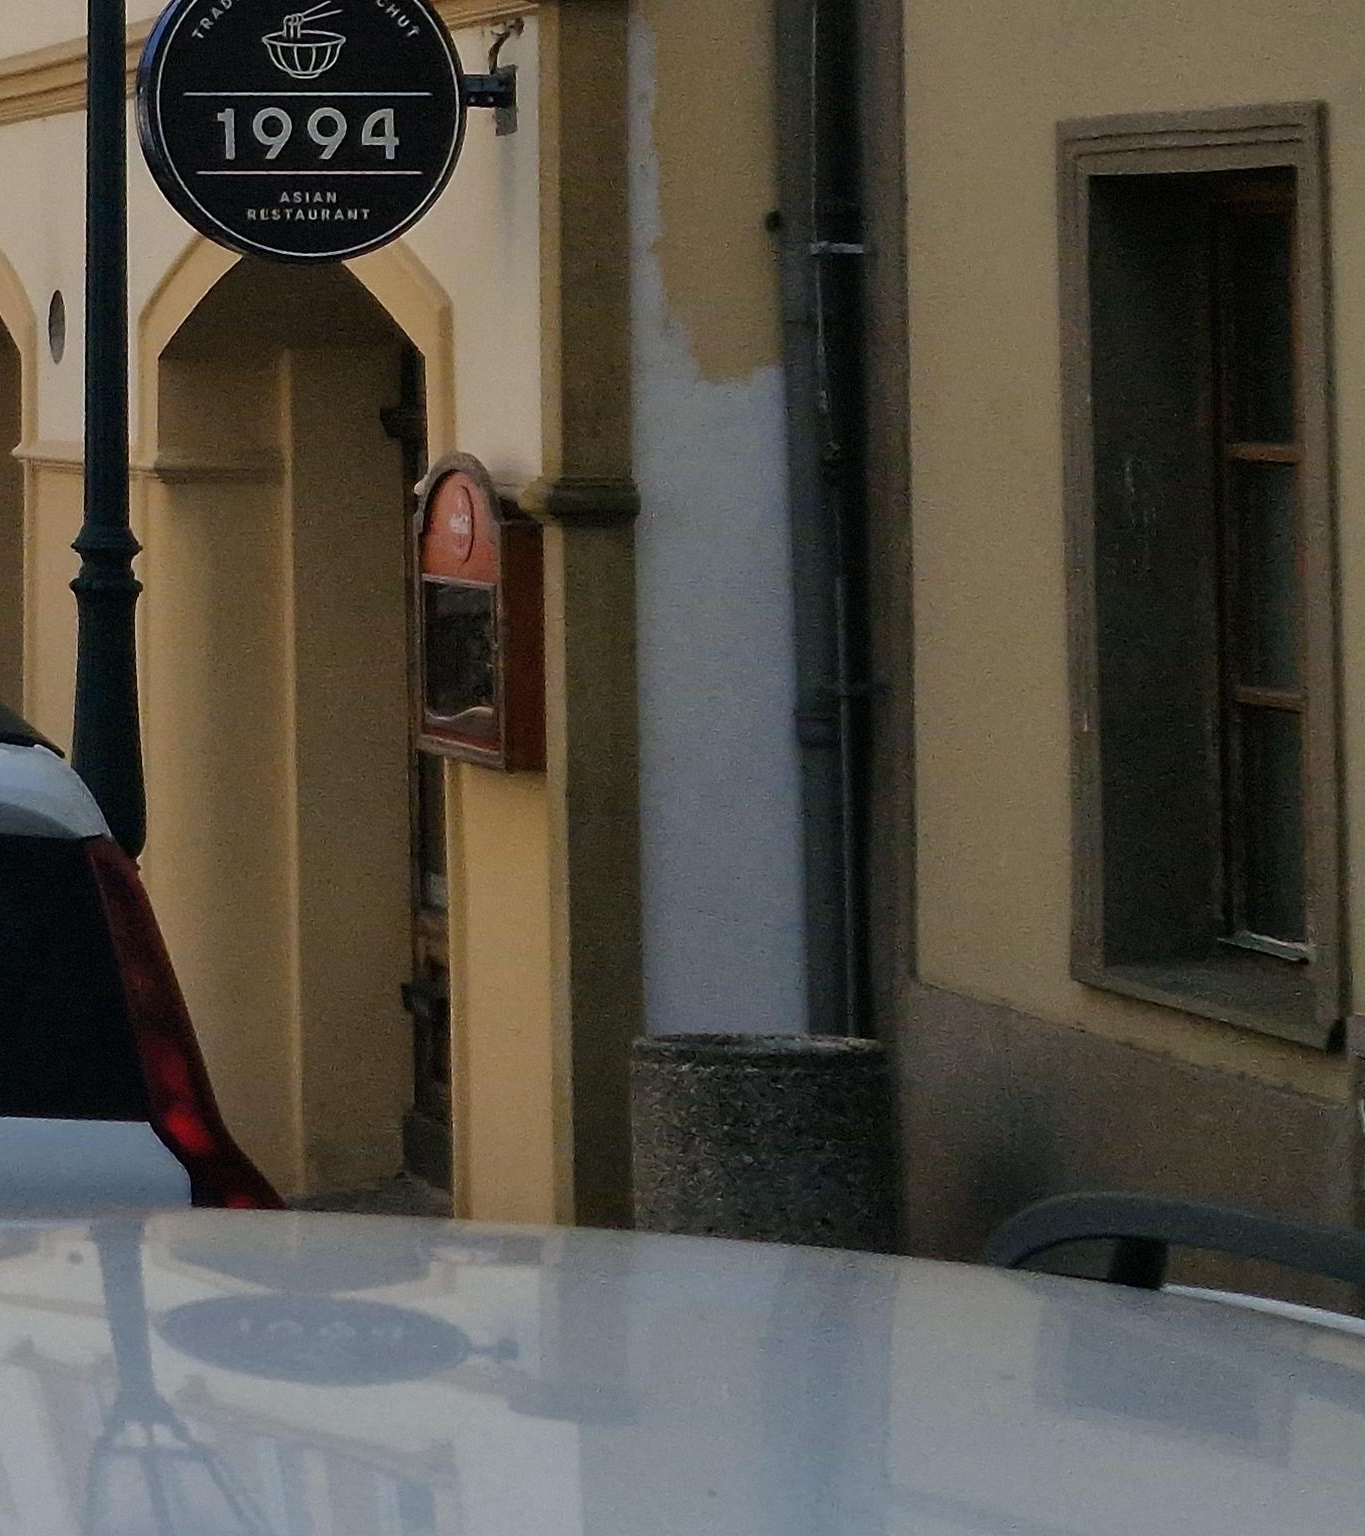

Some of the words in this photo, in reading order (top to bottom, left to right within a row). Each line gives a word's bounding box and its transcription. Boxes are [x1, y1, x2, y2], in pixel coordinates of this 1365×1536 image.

[217, 107, 400, 160] 1994
[279, 191, 337, 204] ASIAN
[246, 208, 371, 221] RESTAURANT
